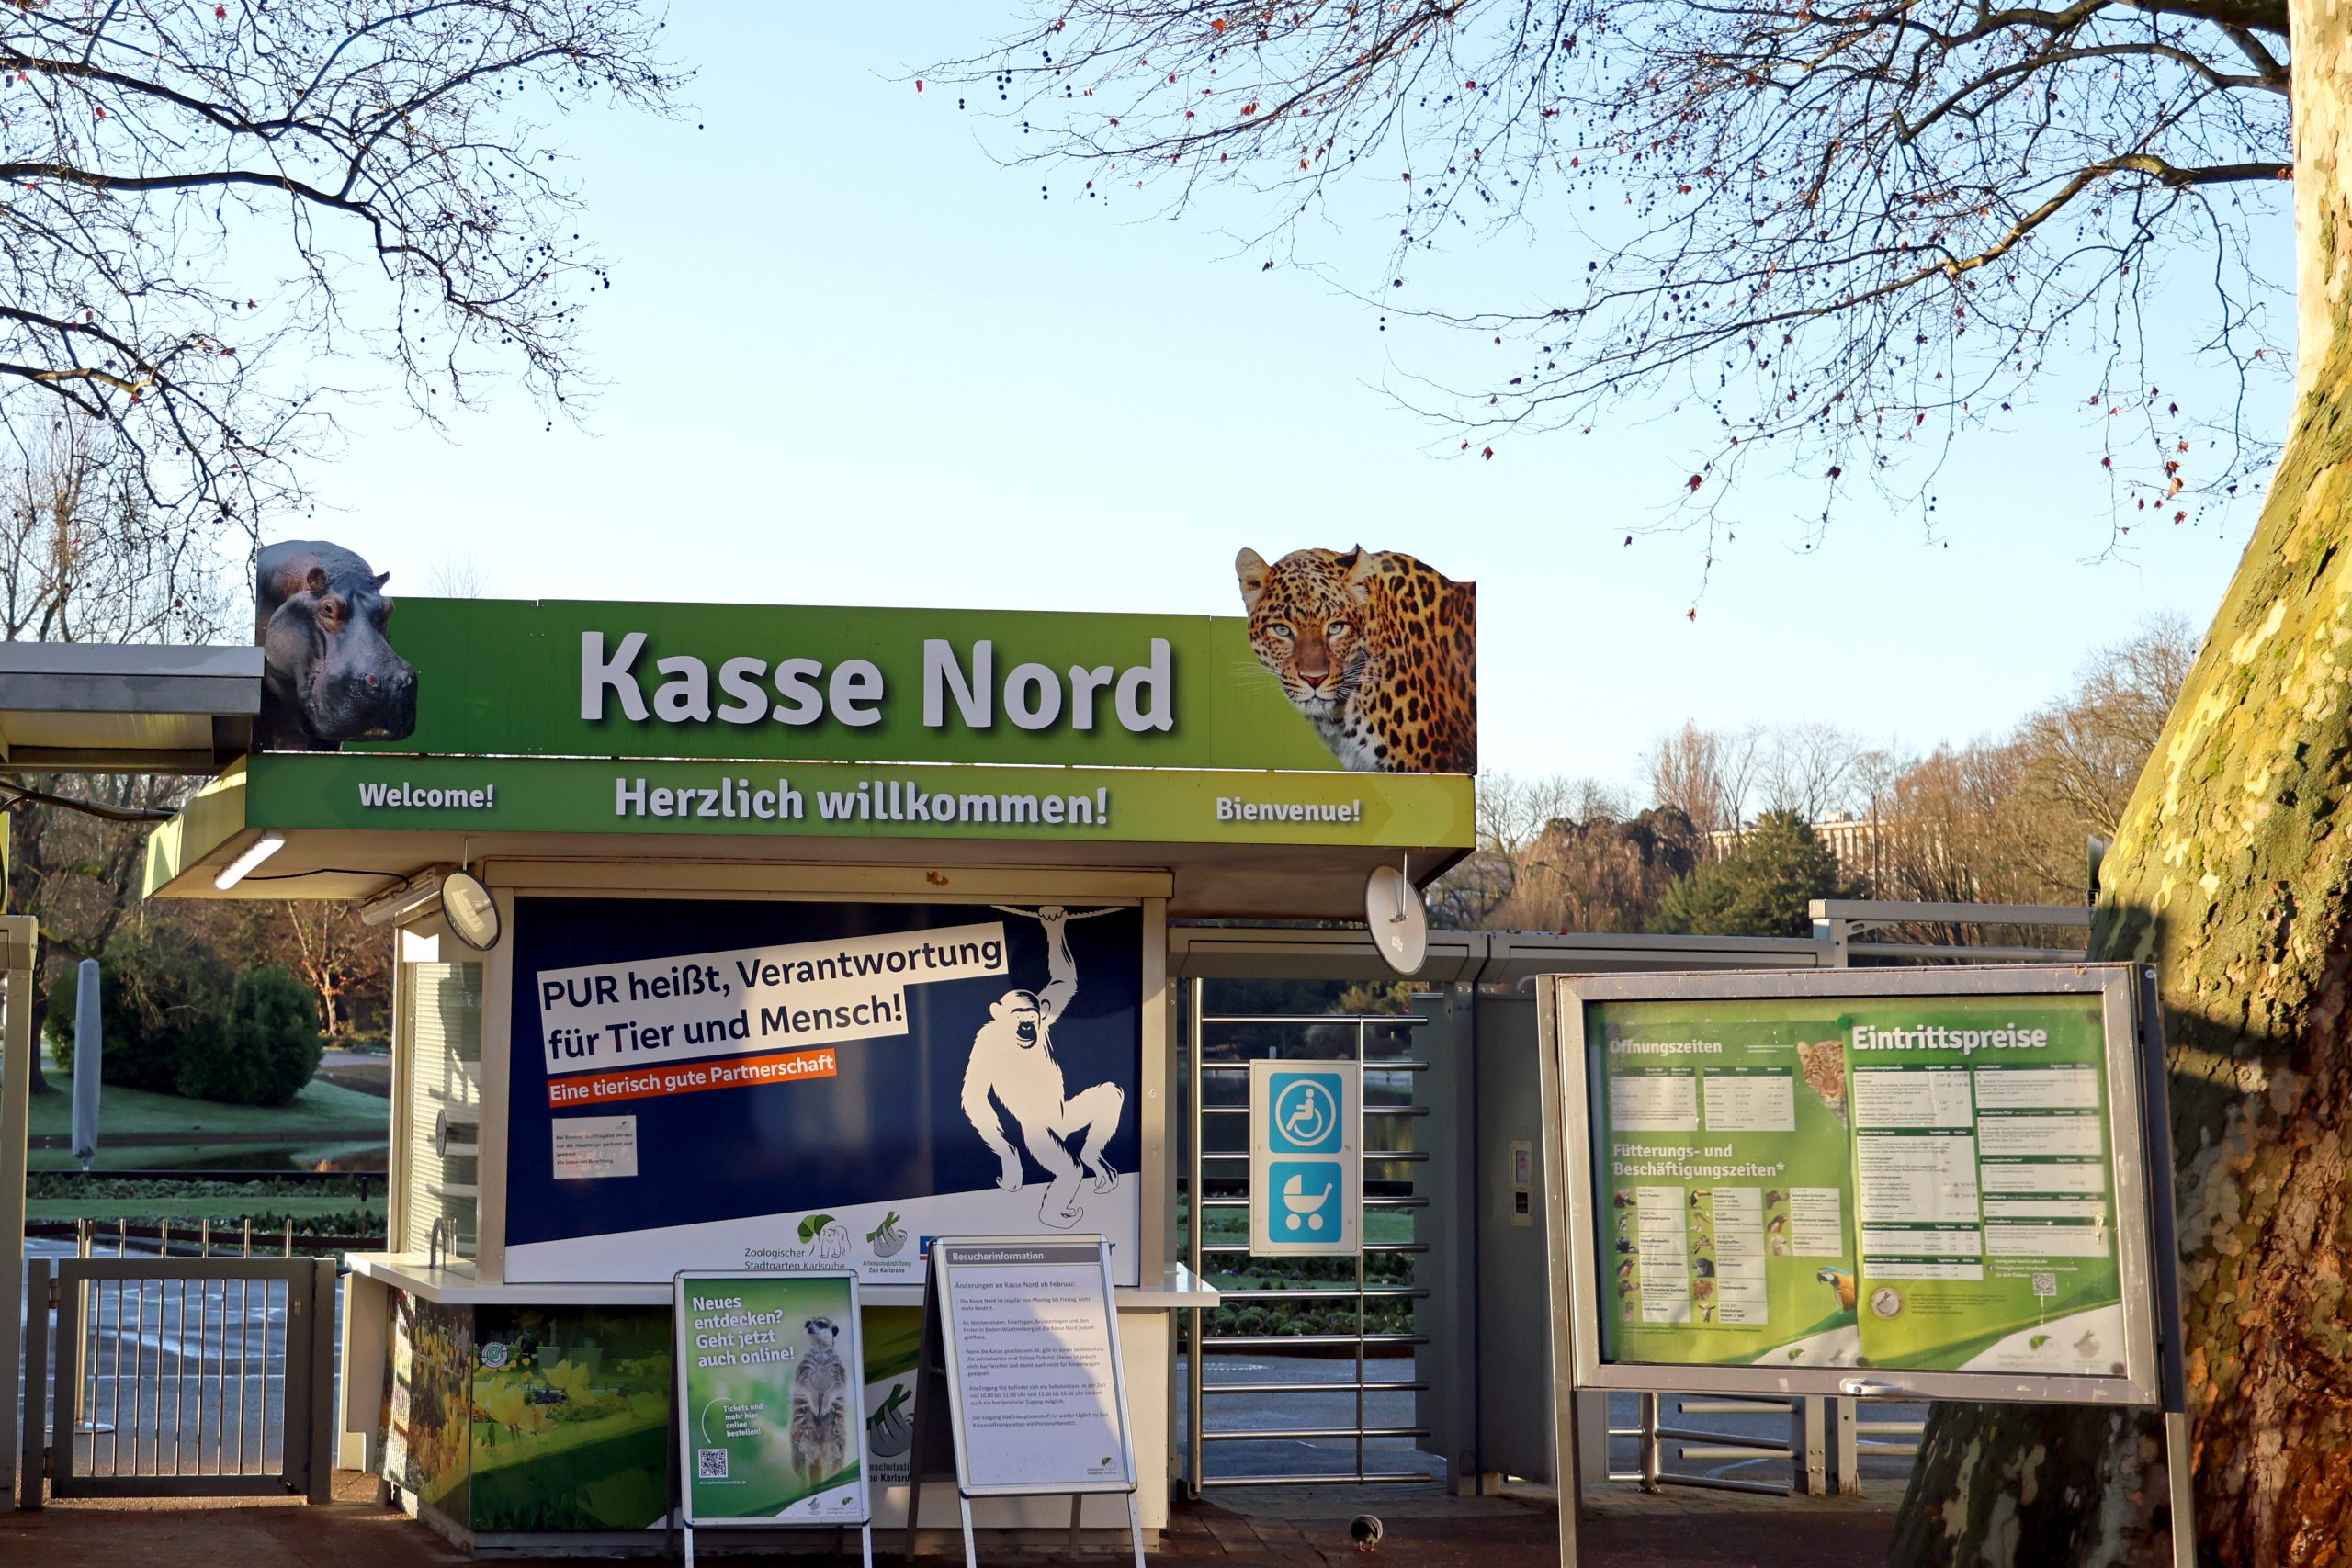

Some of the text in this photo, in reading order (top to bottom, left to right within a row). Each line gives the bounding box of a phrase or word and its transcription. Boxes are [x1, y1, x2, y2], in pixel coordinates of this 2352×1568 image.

[580, 631, 1174, 733] Kasse Nord
[358, 782, 494, 807] Welcome!
[615, 777, 1108, 825] Herzlich willkommen!
[1216, 796, 1361, 822] Bienvenue!
[543, 940, 1001, 1010] PUR heißt, Verantwortung
[548, 992, 903, 1059] für Tier und Mensch!
[1852, 1023, 2048, 1055] Eintrittspreise
[549, 1054, 834, 1101] Eine tierisch gute Partnerschaft
[1613, 1143, 1733, 1161] Fütterungs- und
[745, 1247, 805, 1259] Zoologischer
[952, 1251, 1044, 1261] Besucherinformation
[745, 1260, 845, 1269] Stadtgarten Karlsruhe
[862, 1259, 911, 1268] Artenschutzstiftung
[956, 1281, 993, 1290] Änderungen
[692, 1296, 742, 1311] Neues
[695, 1309, 784, 1330] entdecken?
[695, 1329, 776, 1349] Geht jetzt
[698, 1346, 795, 1368] auch online!
[723, 1403, 763, 1413] Tickets und
[725, 1413, 743, 1421] mehr
[726, 1421, 748, 1429] online
[726, 1428, 762, 1438] bestellen!
[869, 1462, 910, 1472] nschutzsti
[880, 1473, 910, 1482] Karlsru
